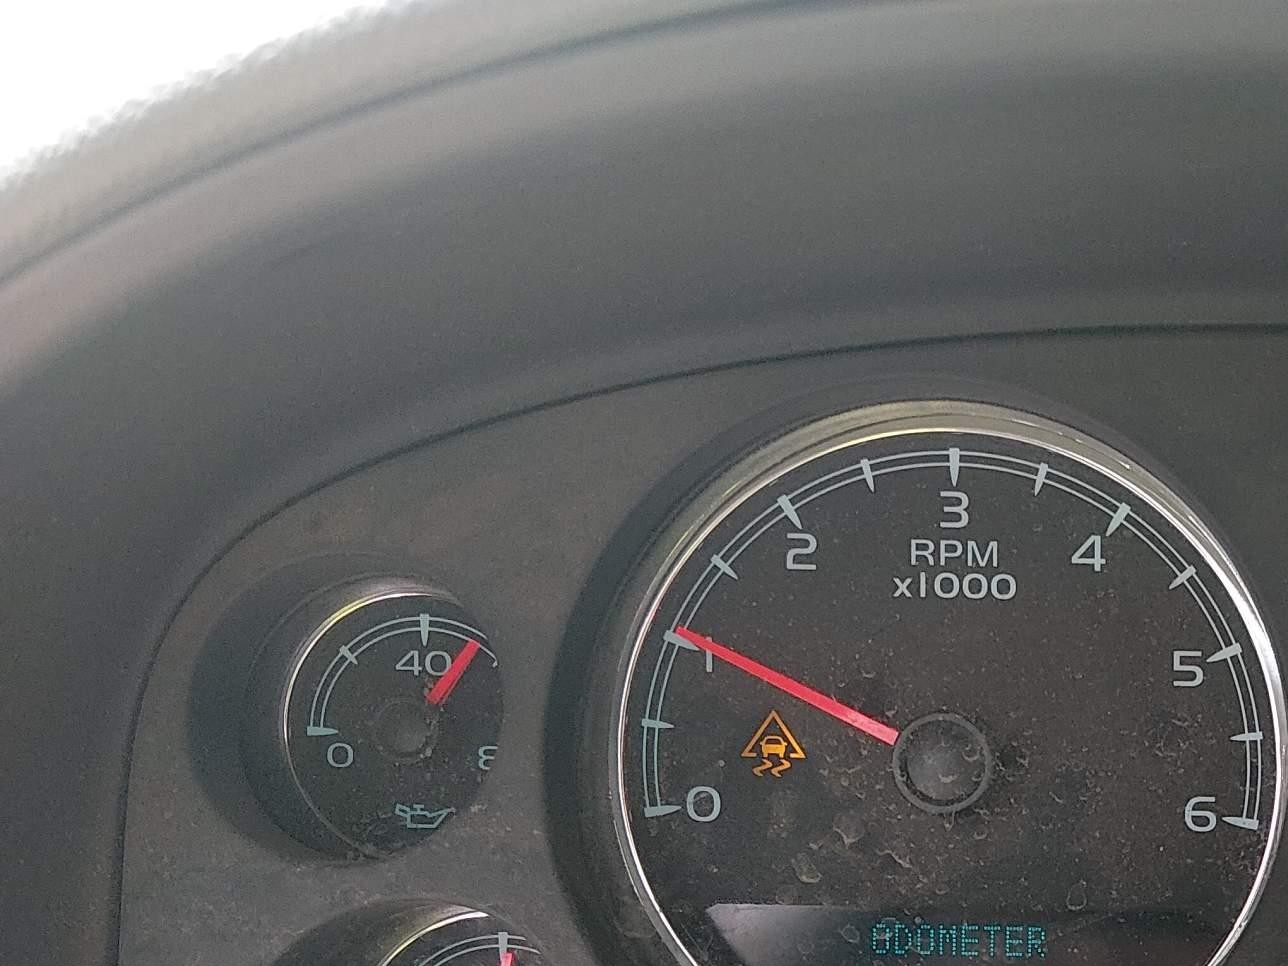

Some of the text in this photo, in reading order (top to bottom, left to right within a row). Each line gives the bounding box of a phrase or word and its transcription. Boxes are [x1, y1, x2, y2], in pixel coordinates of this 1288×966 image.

[940, 491, 969, 528] 3
[786, 533, 818, 570] 2
[910, 540, 999, 567] RPM
[1071, 535, 1107, 571] 4
[892, 574, 1017, 600] x1000
[395, 651, 452, 677] 40
[1172, 651, 1205, 687] 5
[326, 742, 355, 769] 0
[686, 786, 722, 823] 0
[1184, 796, 1217, 832] 6
[871, 923, 1046, 957] ODOMETER
